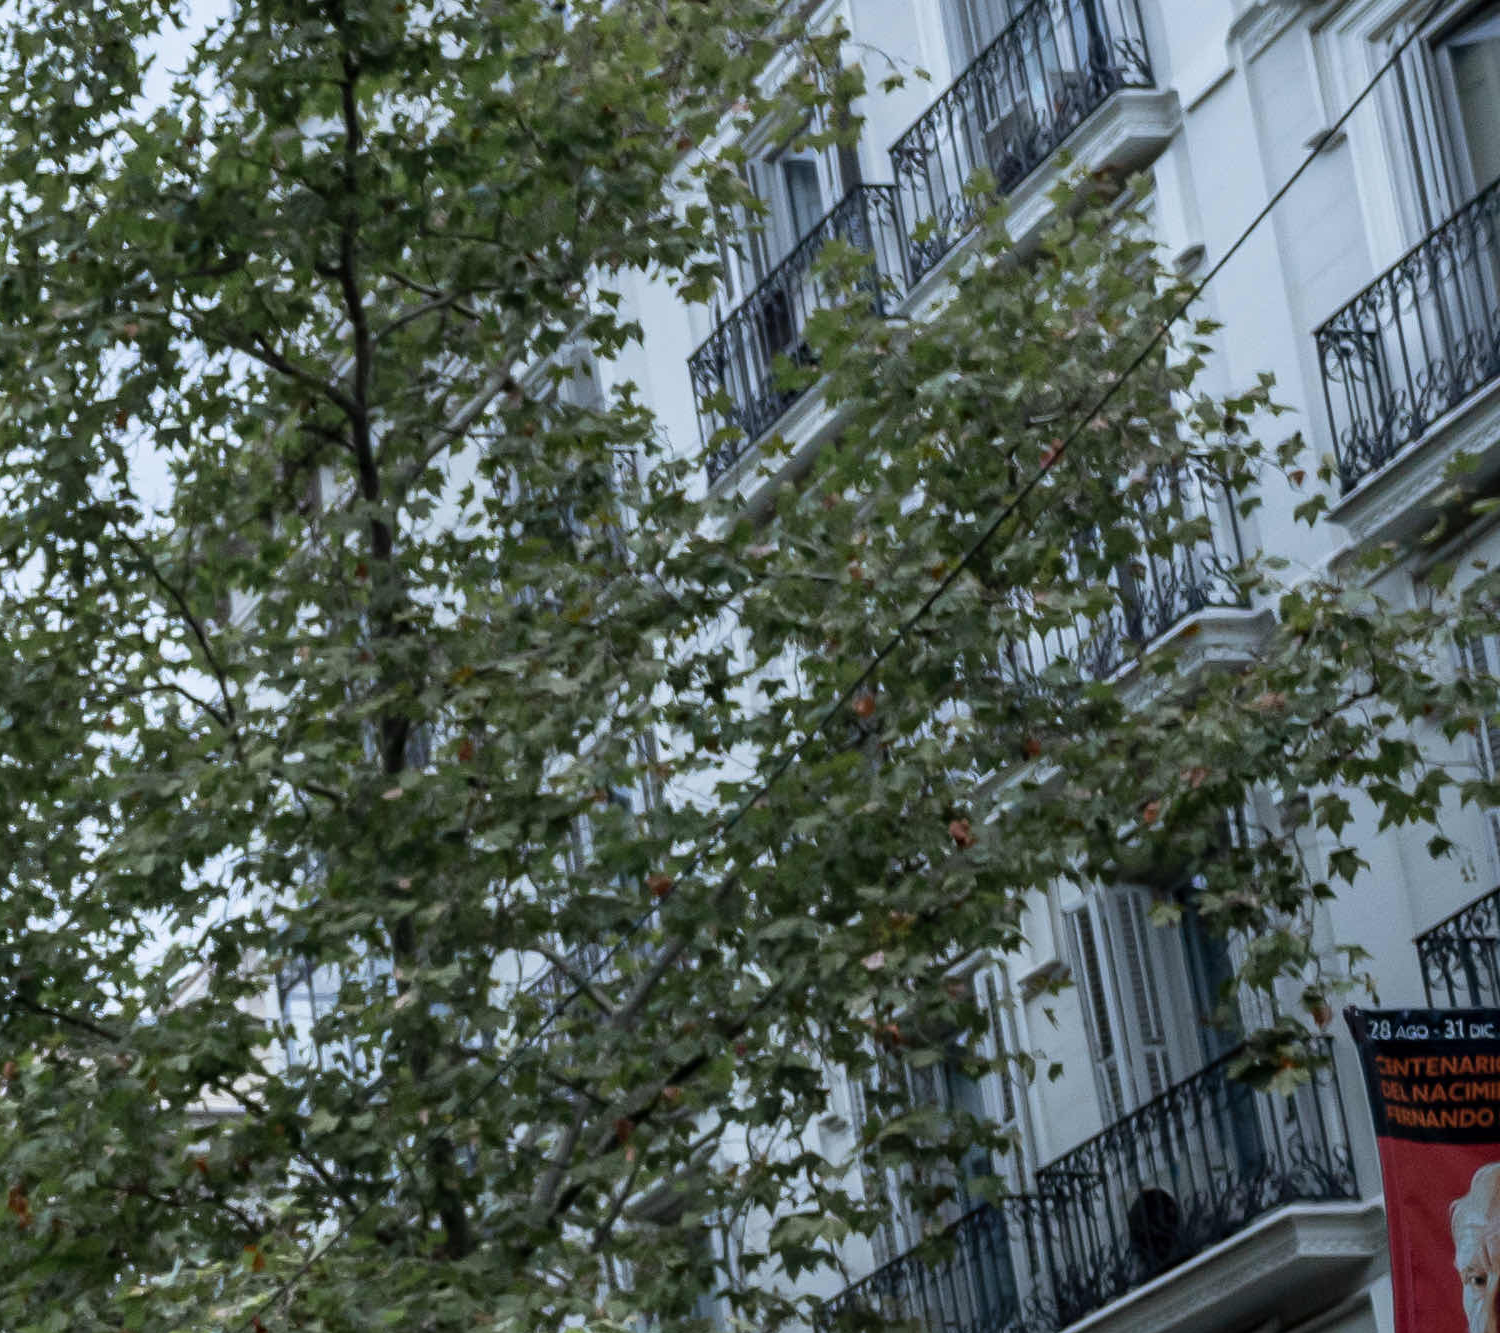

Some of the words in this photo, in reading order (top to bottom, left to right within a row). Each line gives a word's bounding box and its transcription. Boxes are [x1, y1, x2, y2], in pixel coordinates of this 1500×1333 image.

[1369, 1019, 1391, 1040] 28
[1395, 1024, 1429, 1040] AGO
[1444, 1019, 1464, 1040] 31
[1469, 1023, 1496, 1039] DIC
[1412, 1081, 1500, 1102] NACIMI
